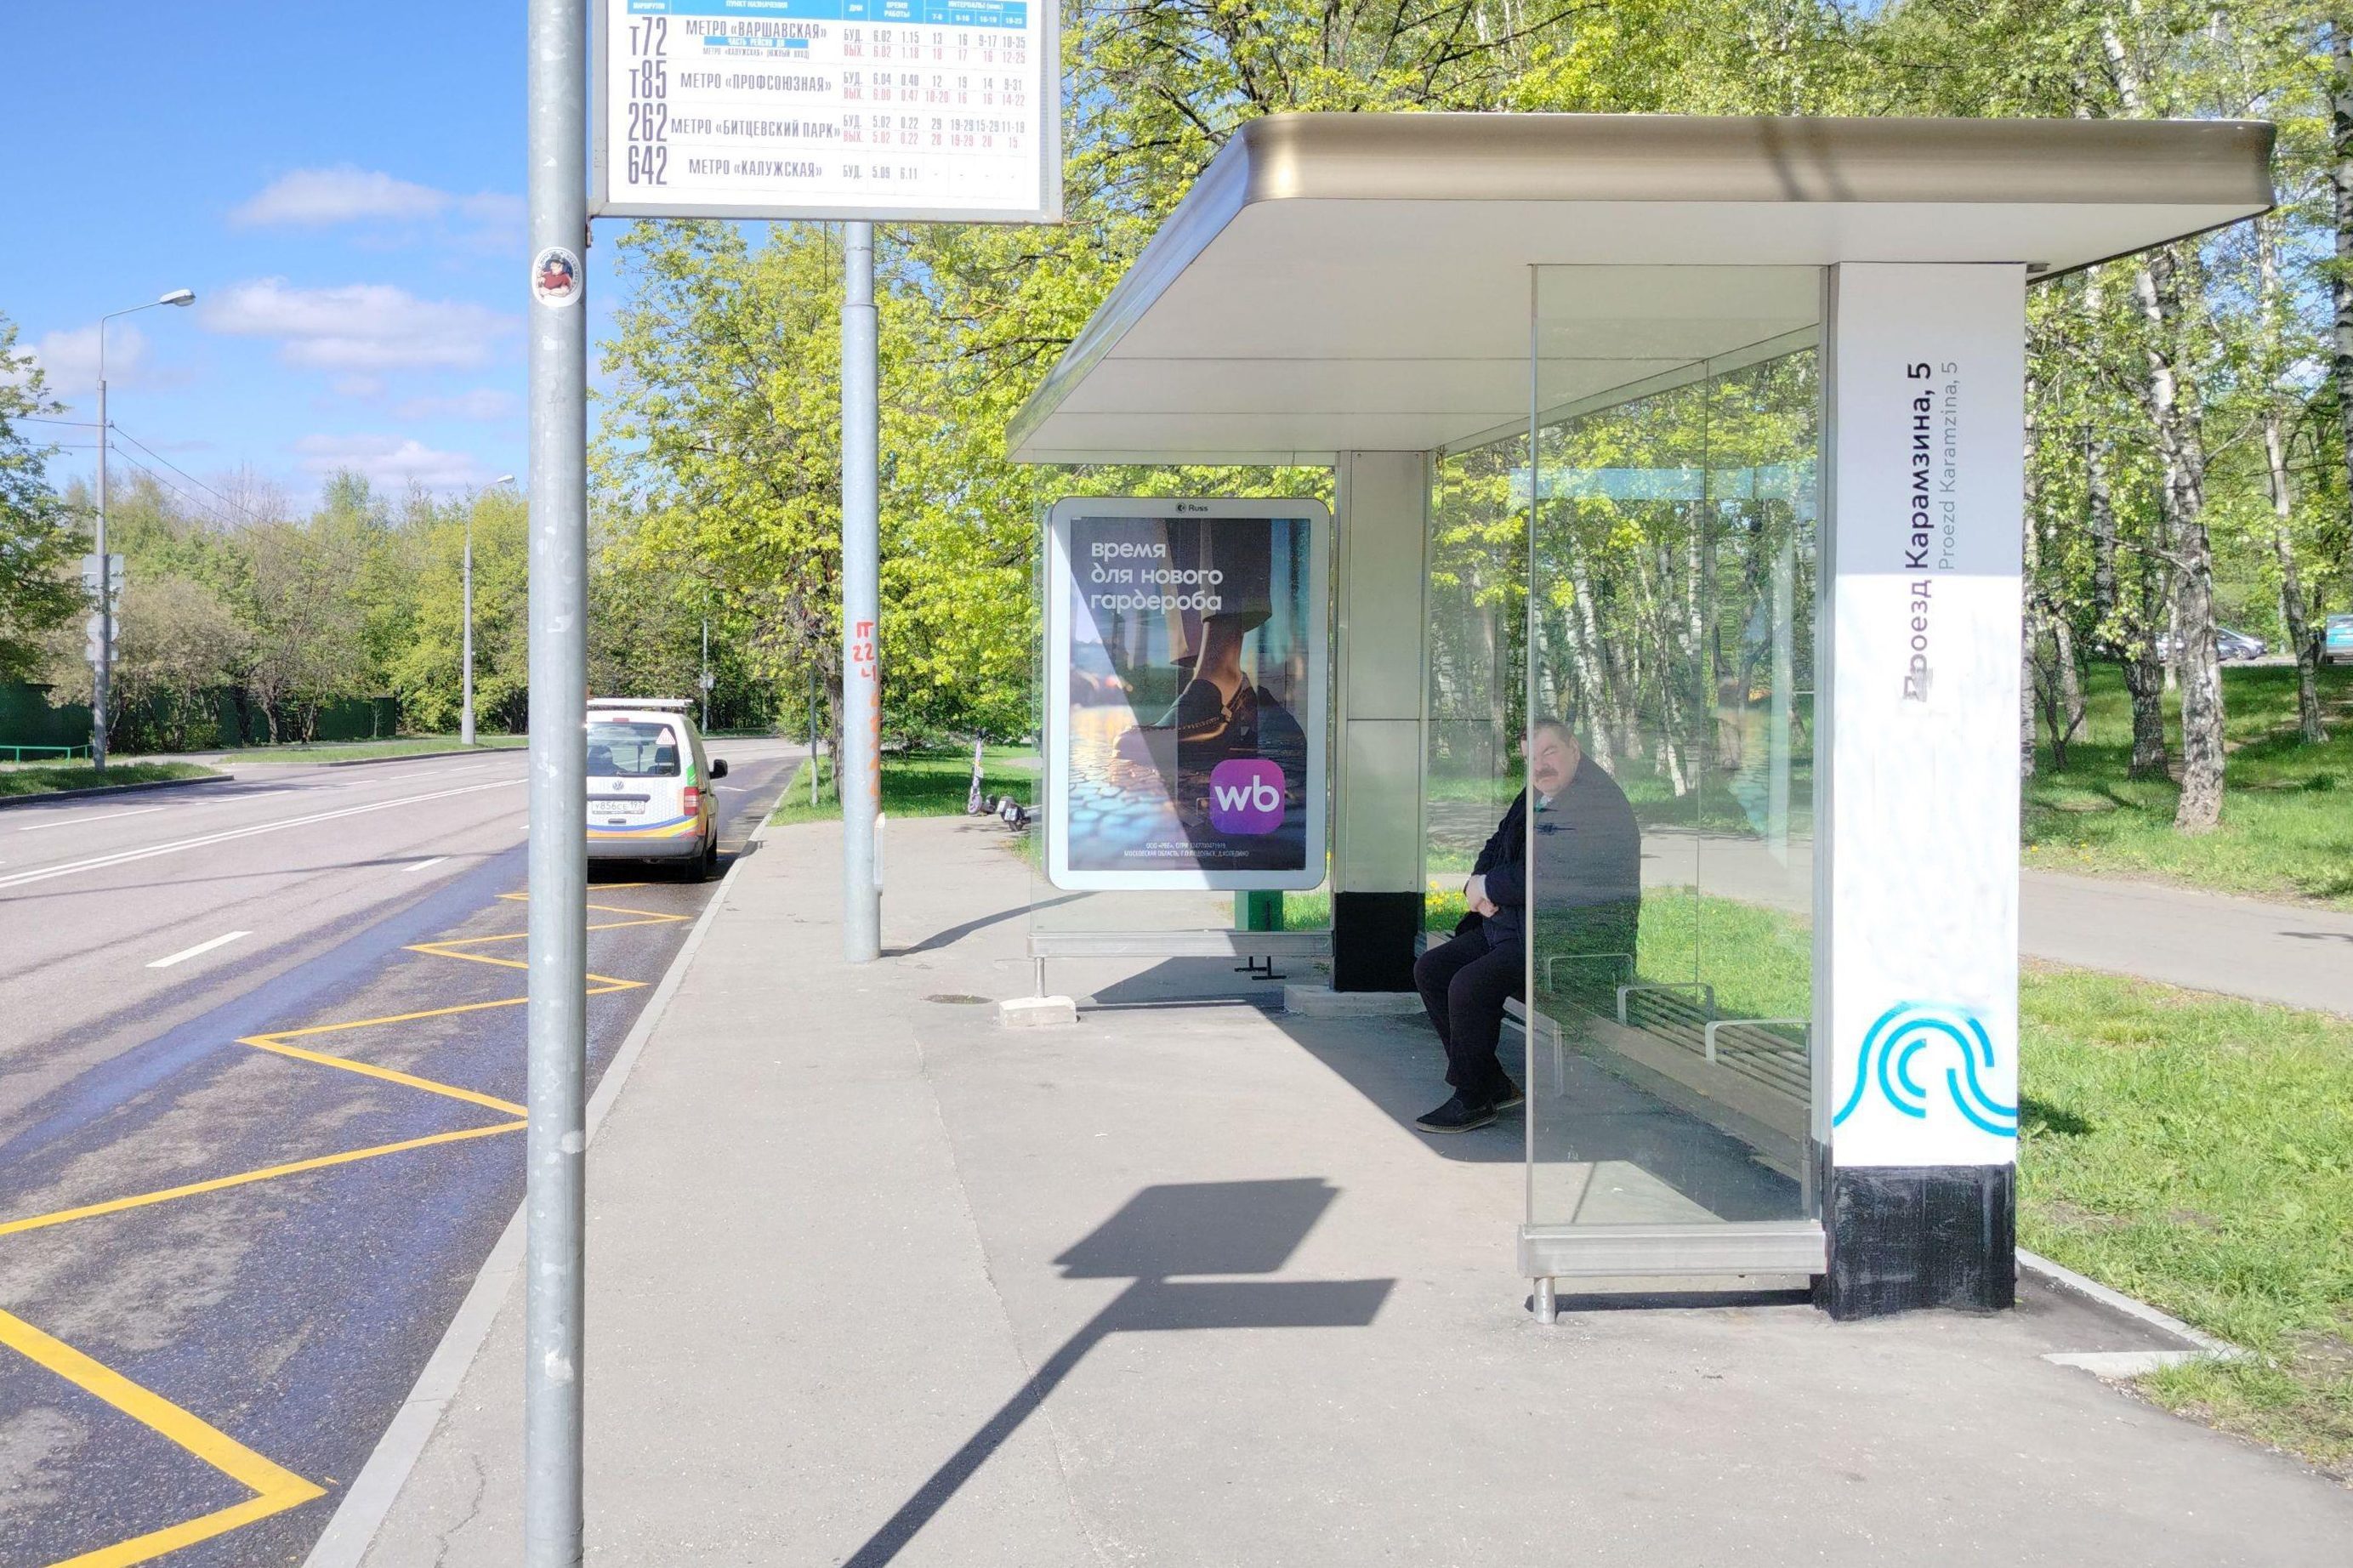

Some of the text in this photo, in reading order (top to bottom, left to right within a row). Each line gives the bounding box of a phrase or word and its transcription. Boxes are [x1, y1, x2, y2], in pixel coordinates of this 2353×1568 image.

[685, 20, 827, 39] МЕТРО «ВАРШАВСКАЯ»
[901, 31, 919, 44] 1.15
[958, 48, 968, 61] 17
[679, 72, 832, 92] МЕТРО «ПРОФСОЮЗНАЯ»
[843, 71, 863, 85] БУД.
[932, 75, 942, 88] 12
[983, 77, 993, 90] 14
[628, 102, 668, 142] 262
[670, 118, 841, 139] МЕТРО «БИТЦЕВСКИЙ ПАРК»
[843, 114, 862, 129] БУД.
[901, 116, 918, 129] 0.22
[901, 132, 918, 145] 0.22
[628, 145, 668, 185] 642
[688, 158, 823, 178] МЕТРО «КАЛУЖСКАЯ»
[843, 164, 863, 179] БУД.
[1907, 362, 1931, 379] 5
[1938, 361, 1960, 570] Proezd Karamzina, 5
[1905, 389, 1935, 569] Карамзина,
[1090, 540, 1166, 562] время
[1090, 563, 1224, 586] для нового
[1090, 590, 1223, 615] гардероба
[1214, 775, 1280, 813] wb
